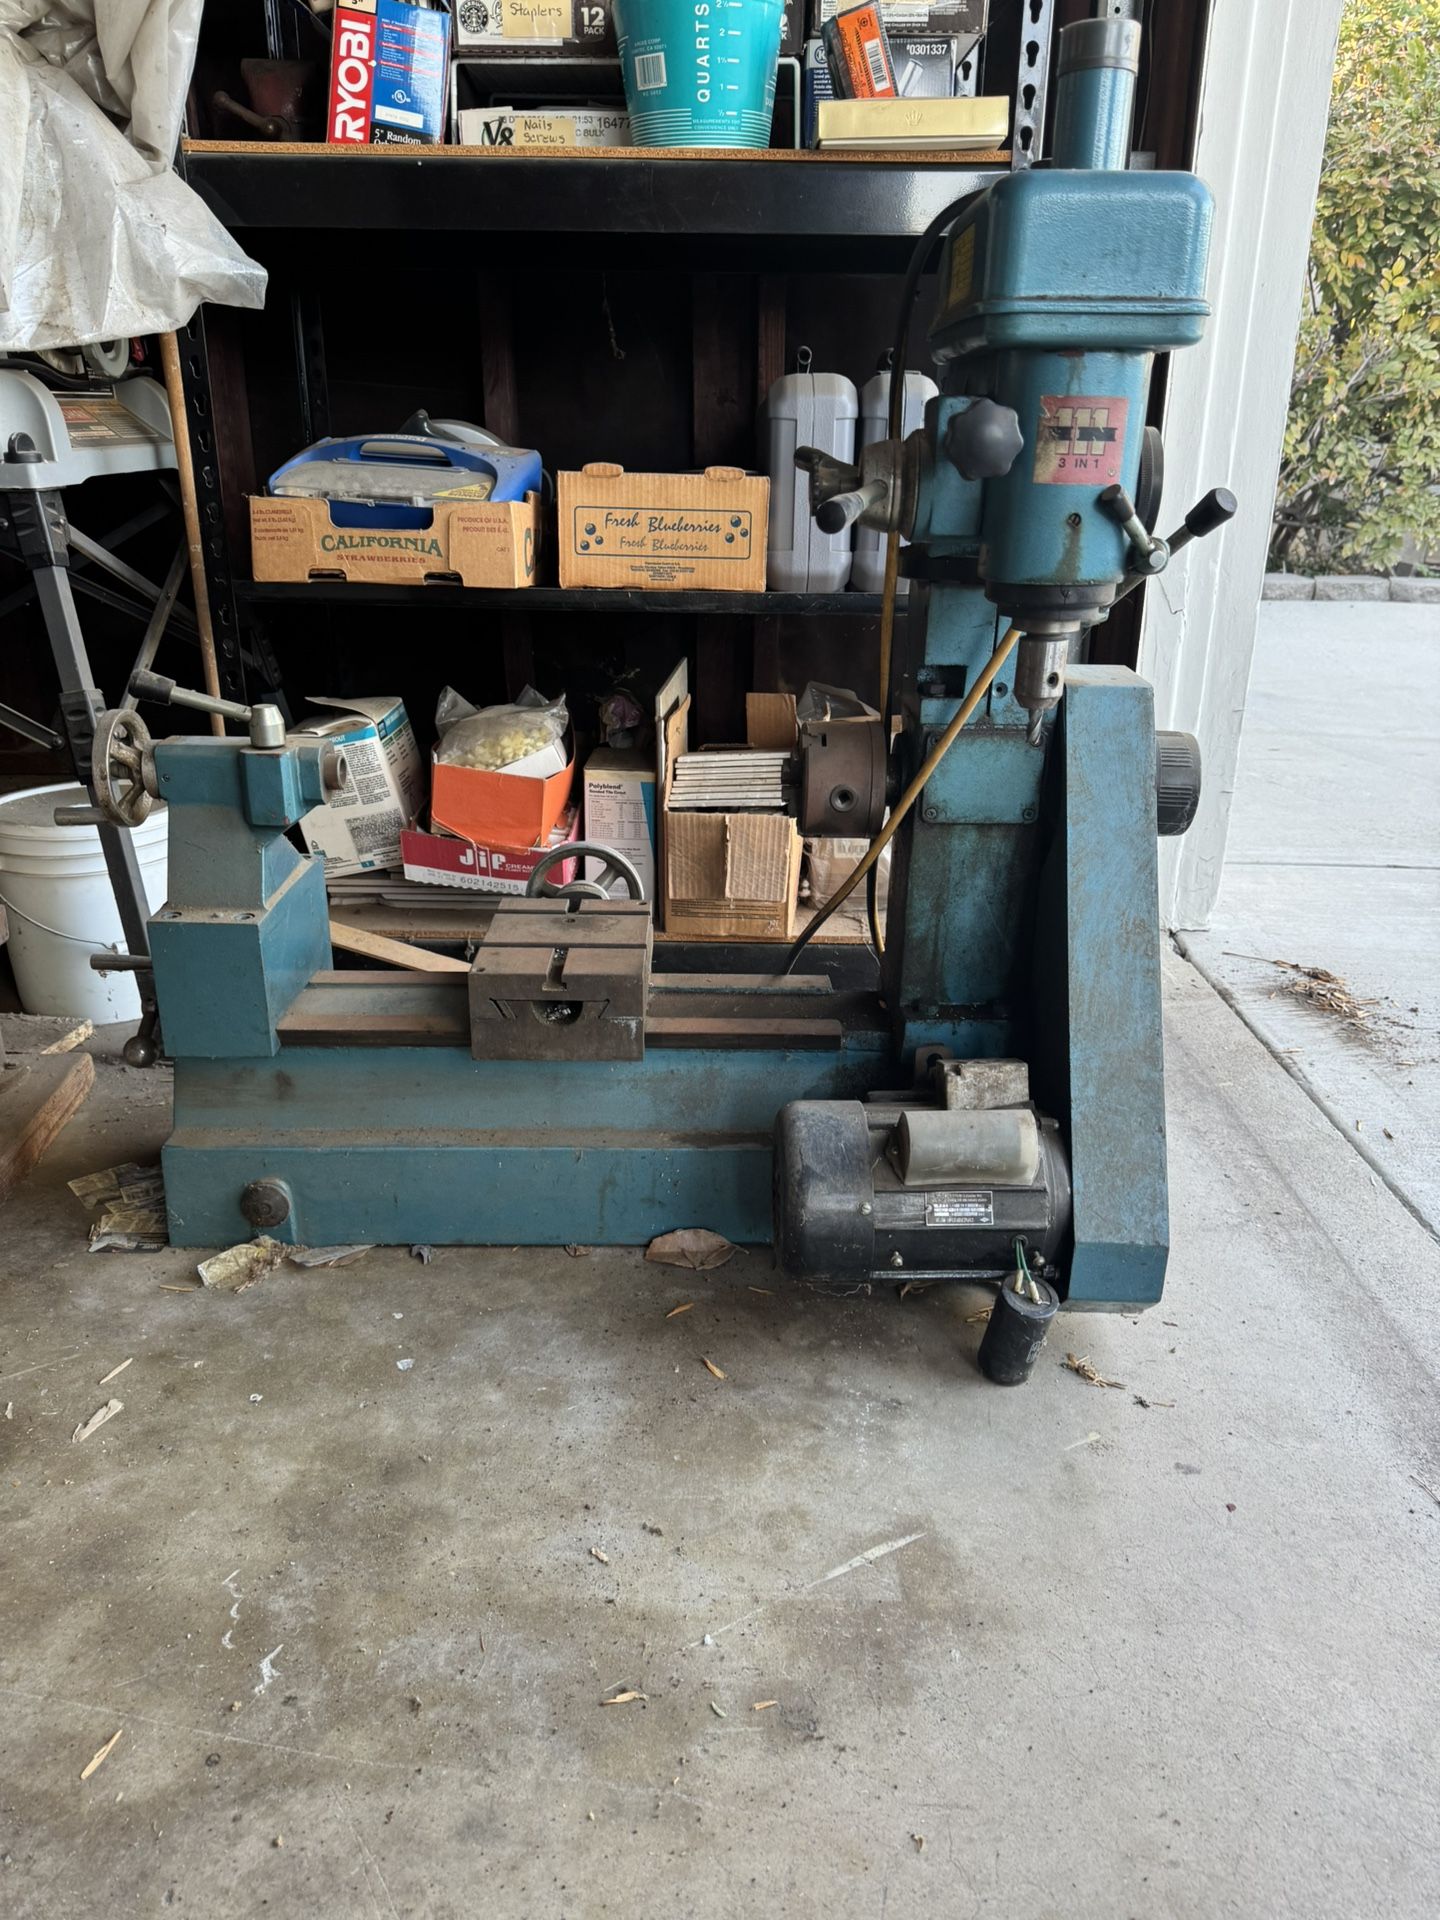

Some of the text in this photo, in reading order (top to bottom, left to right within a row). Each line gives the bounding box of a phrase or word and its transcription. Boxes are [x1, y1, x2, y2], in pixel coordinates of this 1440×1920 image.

[509, 3, 563, 21] Staplers
[581, 7, 605, 26] 12
[584, 26, 604, 35] PACK
[719, 28, 726, 37] 2
[694, 3, 711, 103] QUARTS
[334, 19, 371, 141] RYOBI
[524, 119, 552, 131] Nails
[583, 128, 605, 138] BULK
[386, 130, 422, 146] Random
[524, 132, 566, 144] Screws
[1058, 457, 1099, 468] 3 IN 1
[604, 512, 722, 534] Fresh Blueberries
[320, 534, 443, 559] CALIFORNIA
[619, 535, 708, 552] Fresh Blueberries
[336, 554, 427, 565] STRAWBERRIES
[459, 847, 507, 871] Jif
[459, 875, 520, 892] 602142515
